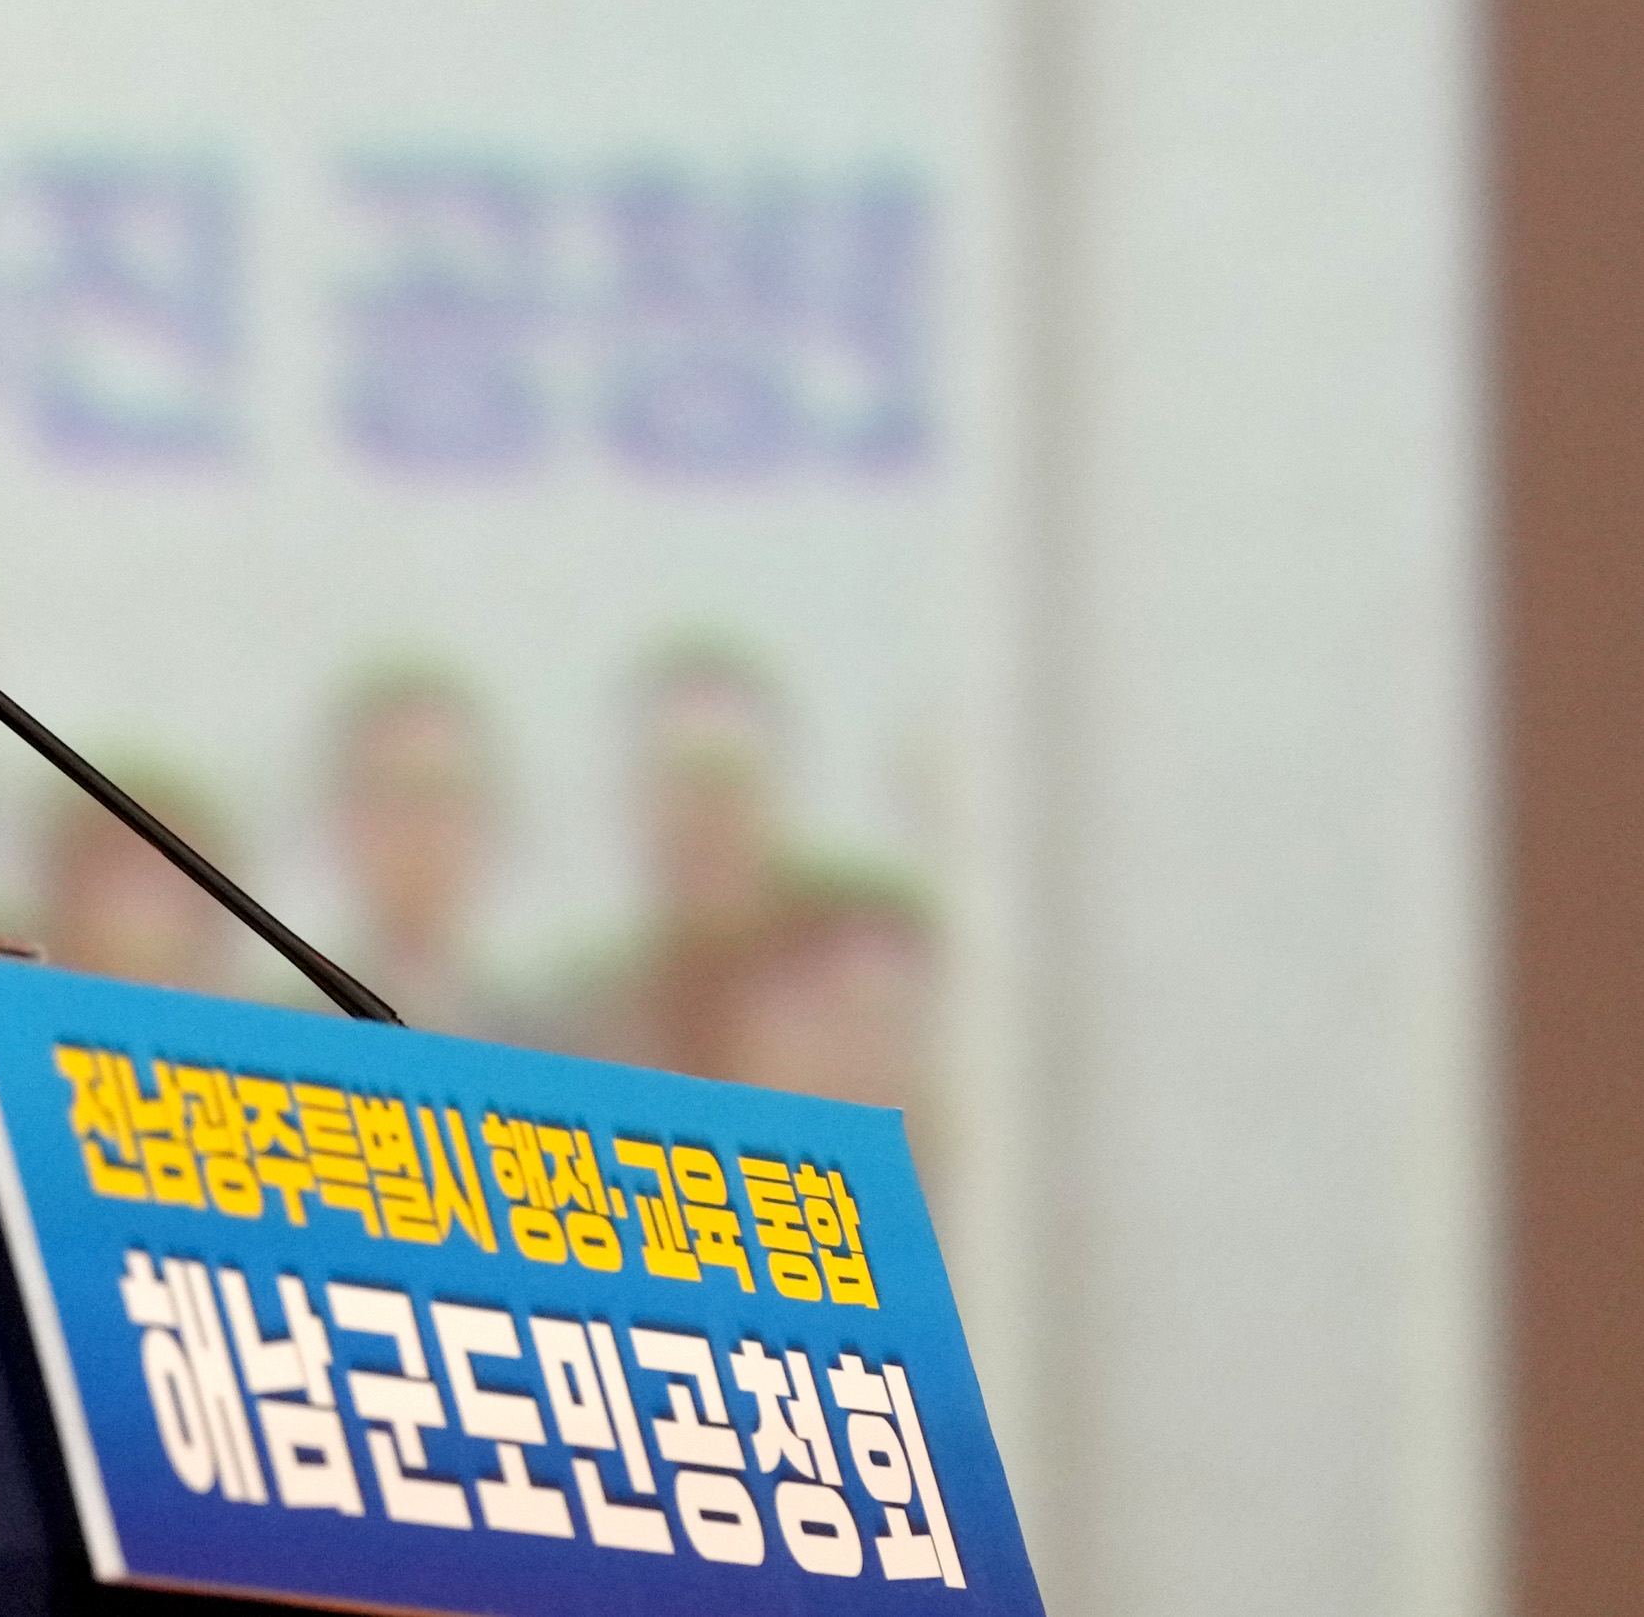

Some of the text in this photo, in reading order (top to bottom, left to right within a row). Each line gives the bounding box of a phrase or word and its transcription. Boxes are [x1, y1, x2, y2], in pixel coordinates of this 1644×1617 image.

[54, 1044, 499, 1253] 전남광주특별시
[737, 1156, 880, 1310] 통합
[118, 1249, 968, 1591] 해남군도민공청회
